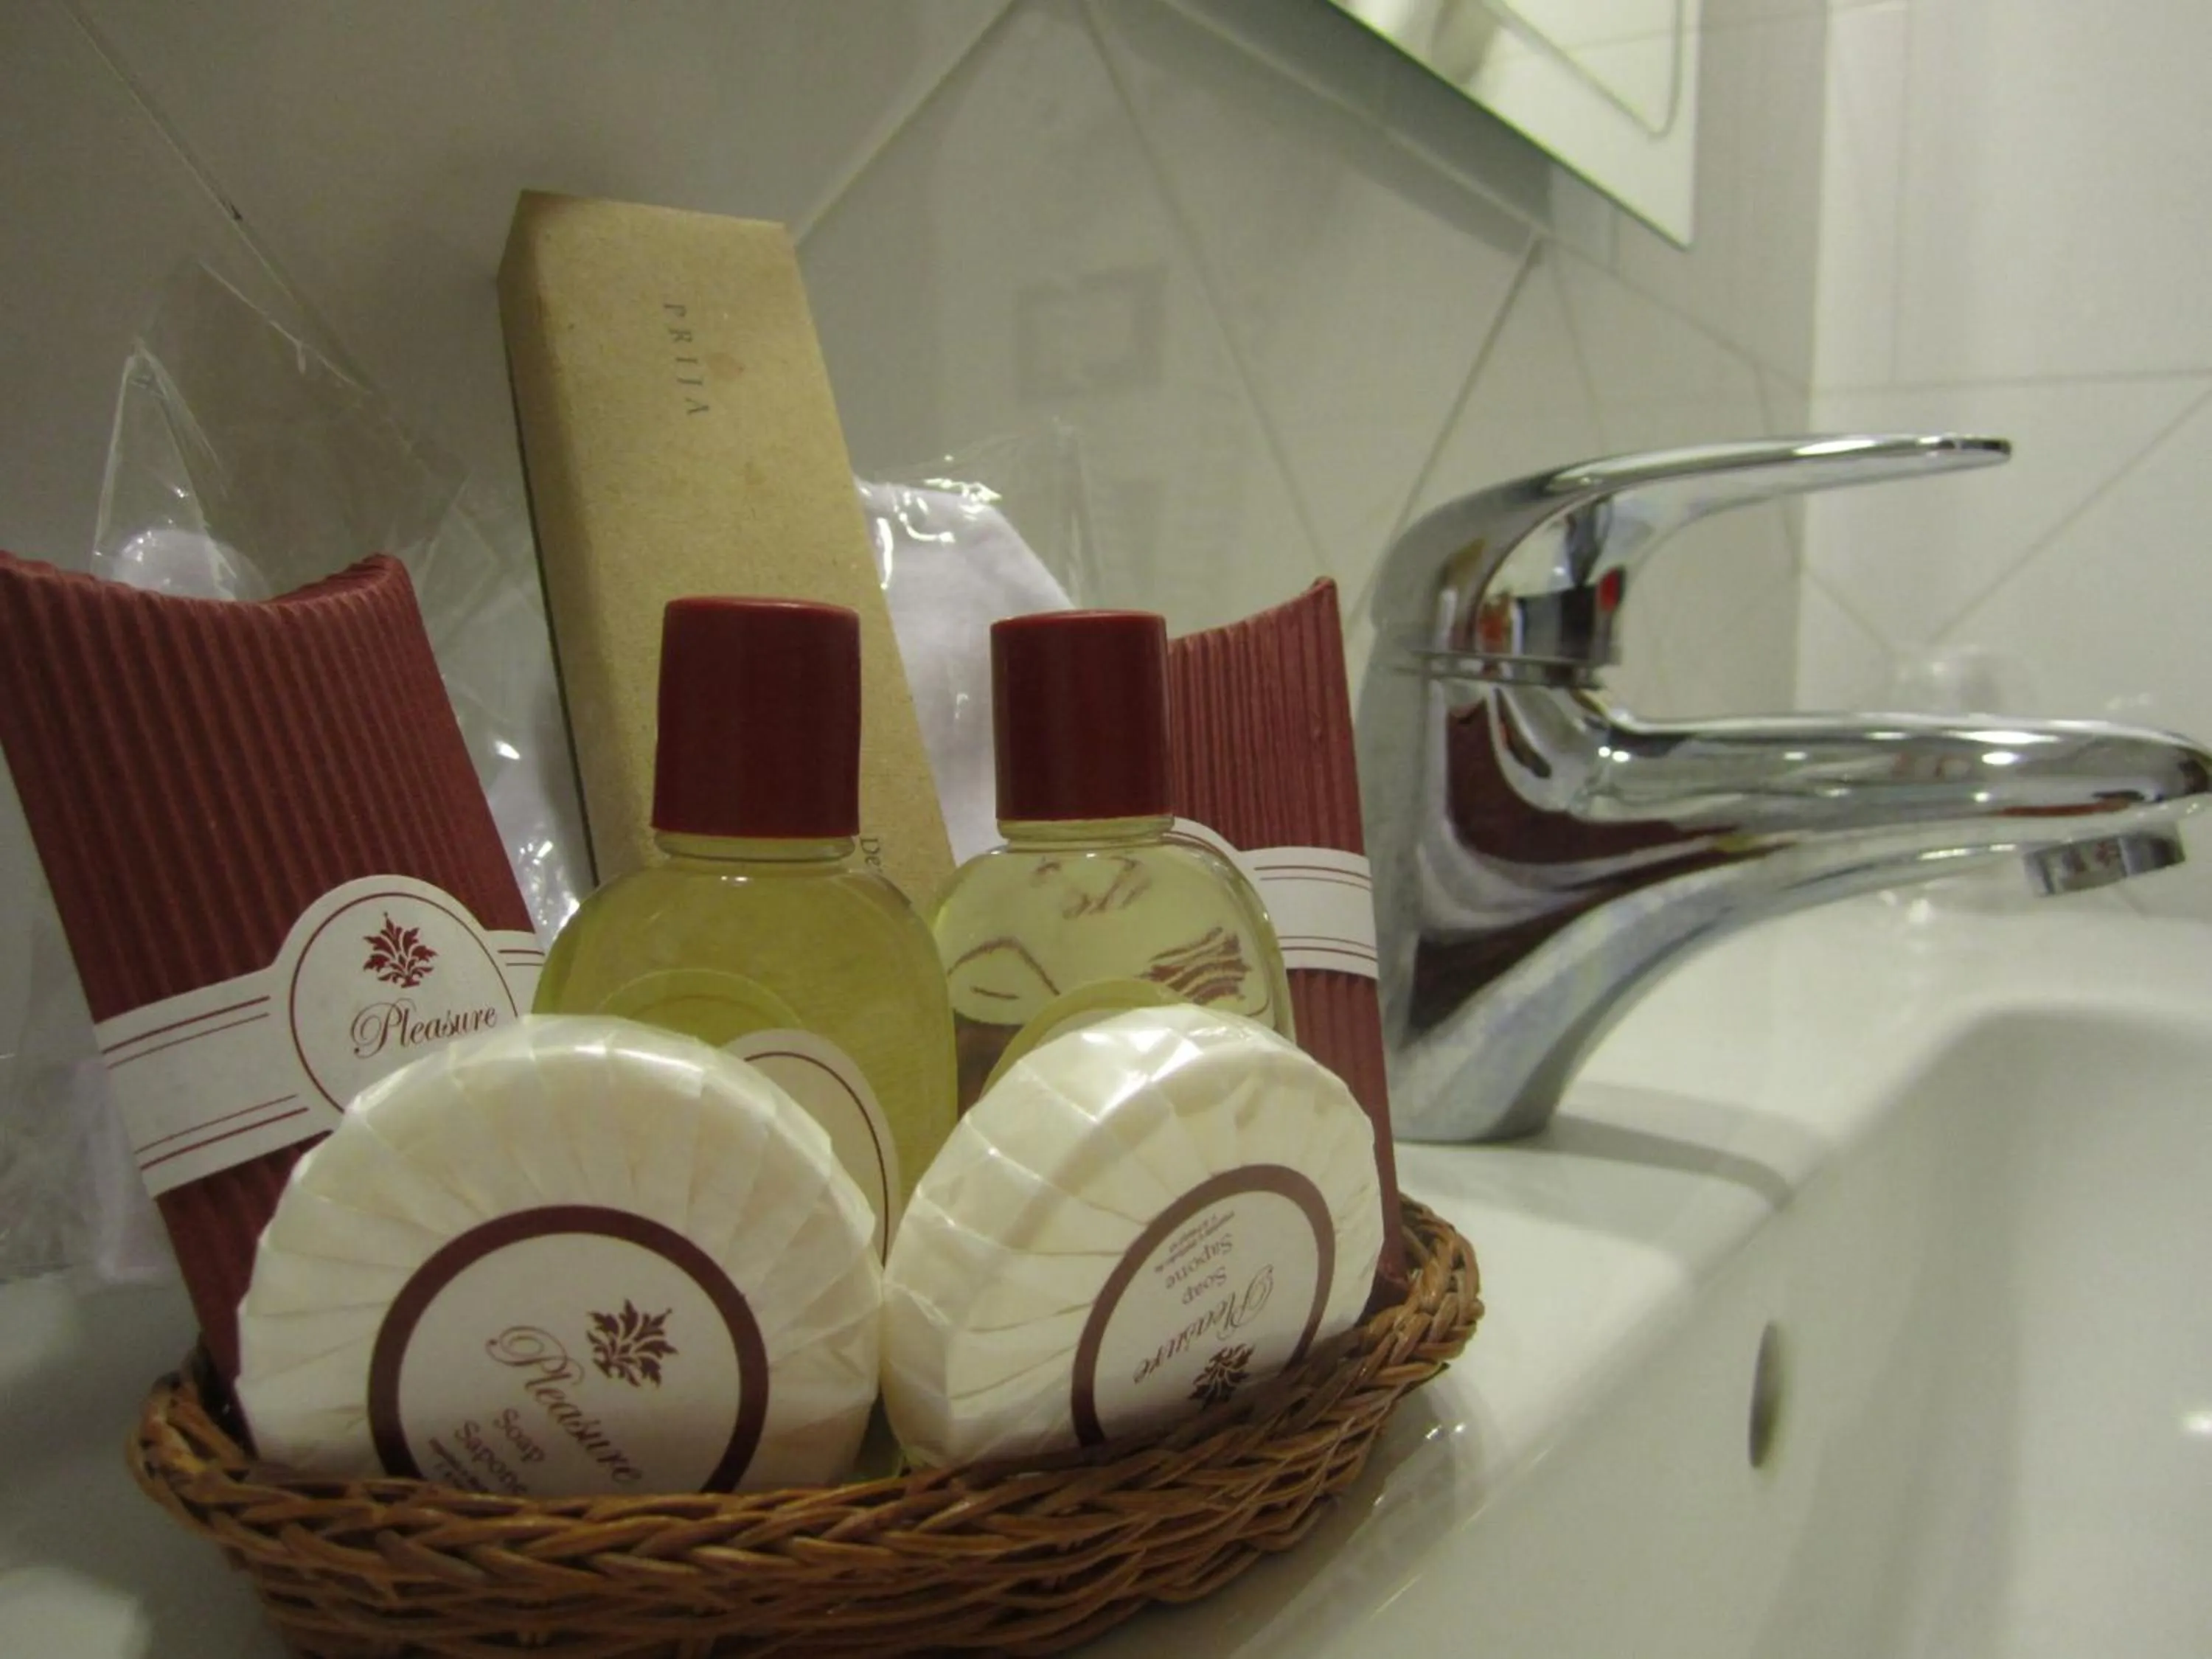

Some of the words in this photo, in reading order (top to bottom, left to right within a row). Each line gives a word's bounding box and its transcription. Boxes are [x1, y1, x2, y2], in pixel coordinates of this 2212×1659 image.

[349, 997, 498, 1059] Pleasure
[1164, 1233, 1234, 1290] Sapone
[1181, 1265, 1228, 1306] Soap
[1133, 1264, 1274, 1385] Pleasure
[484, 1325, 643, 1484] Pleasure
[492, 1407, 546, 1464] Soap
[453, 1419, 529, 1495] Sapone
